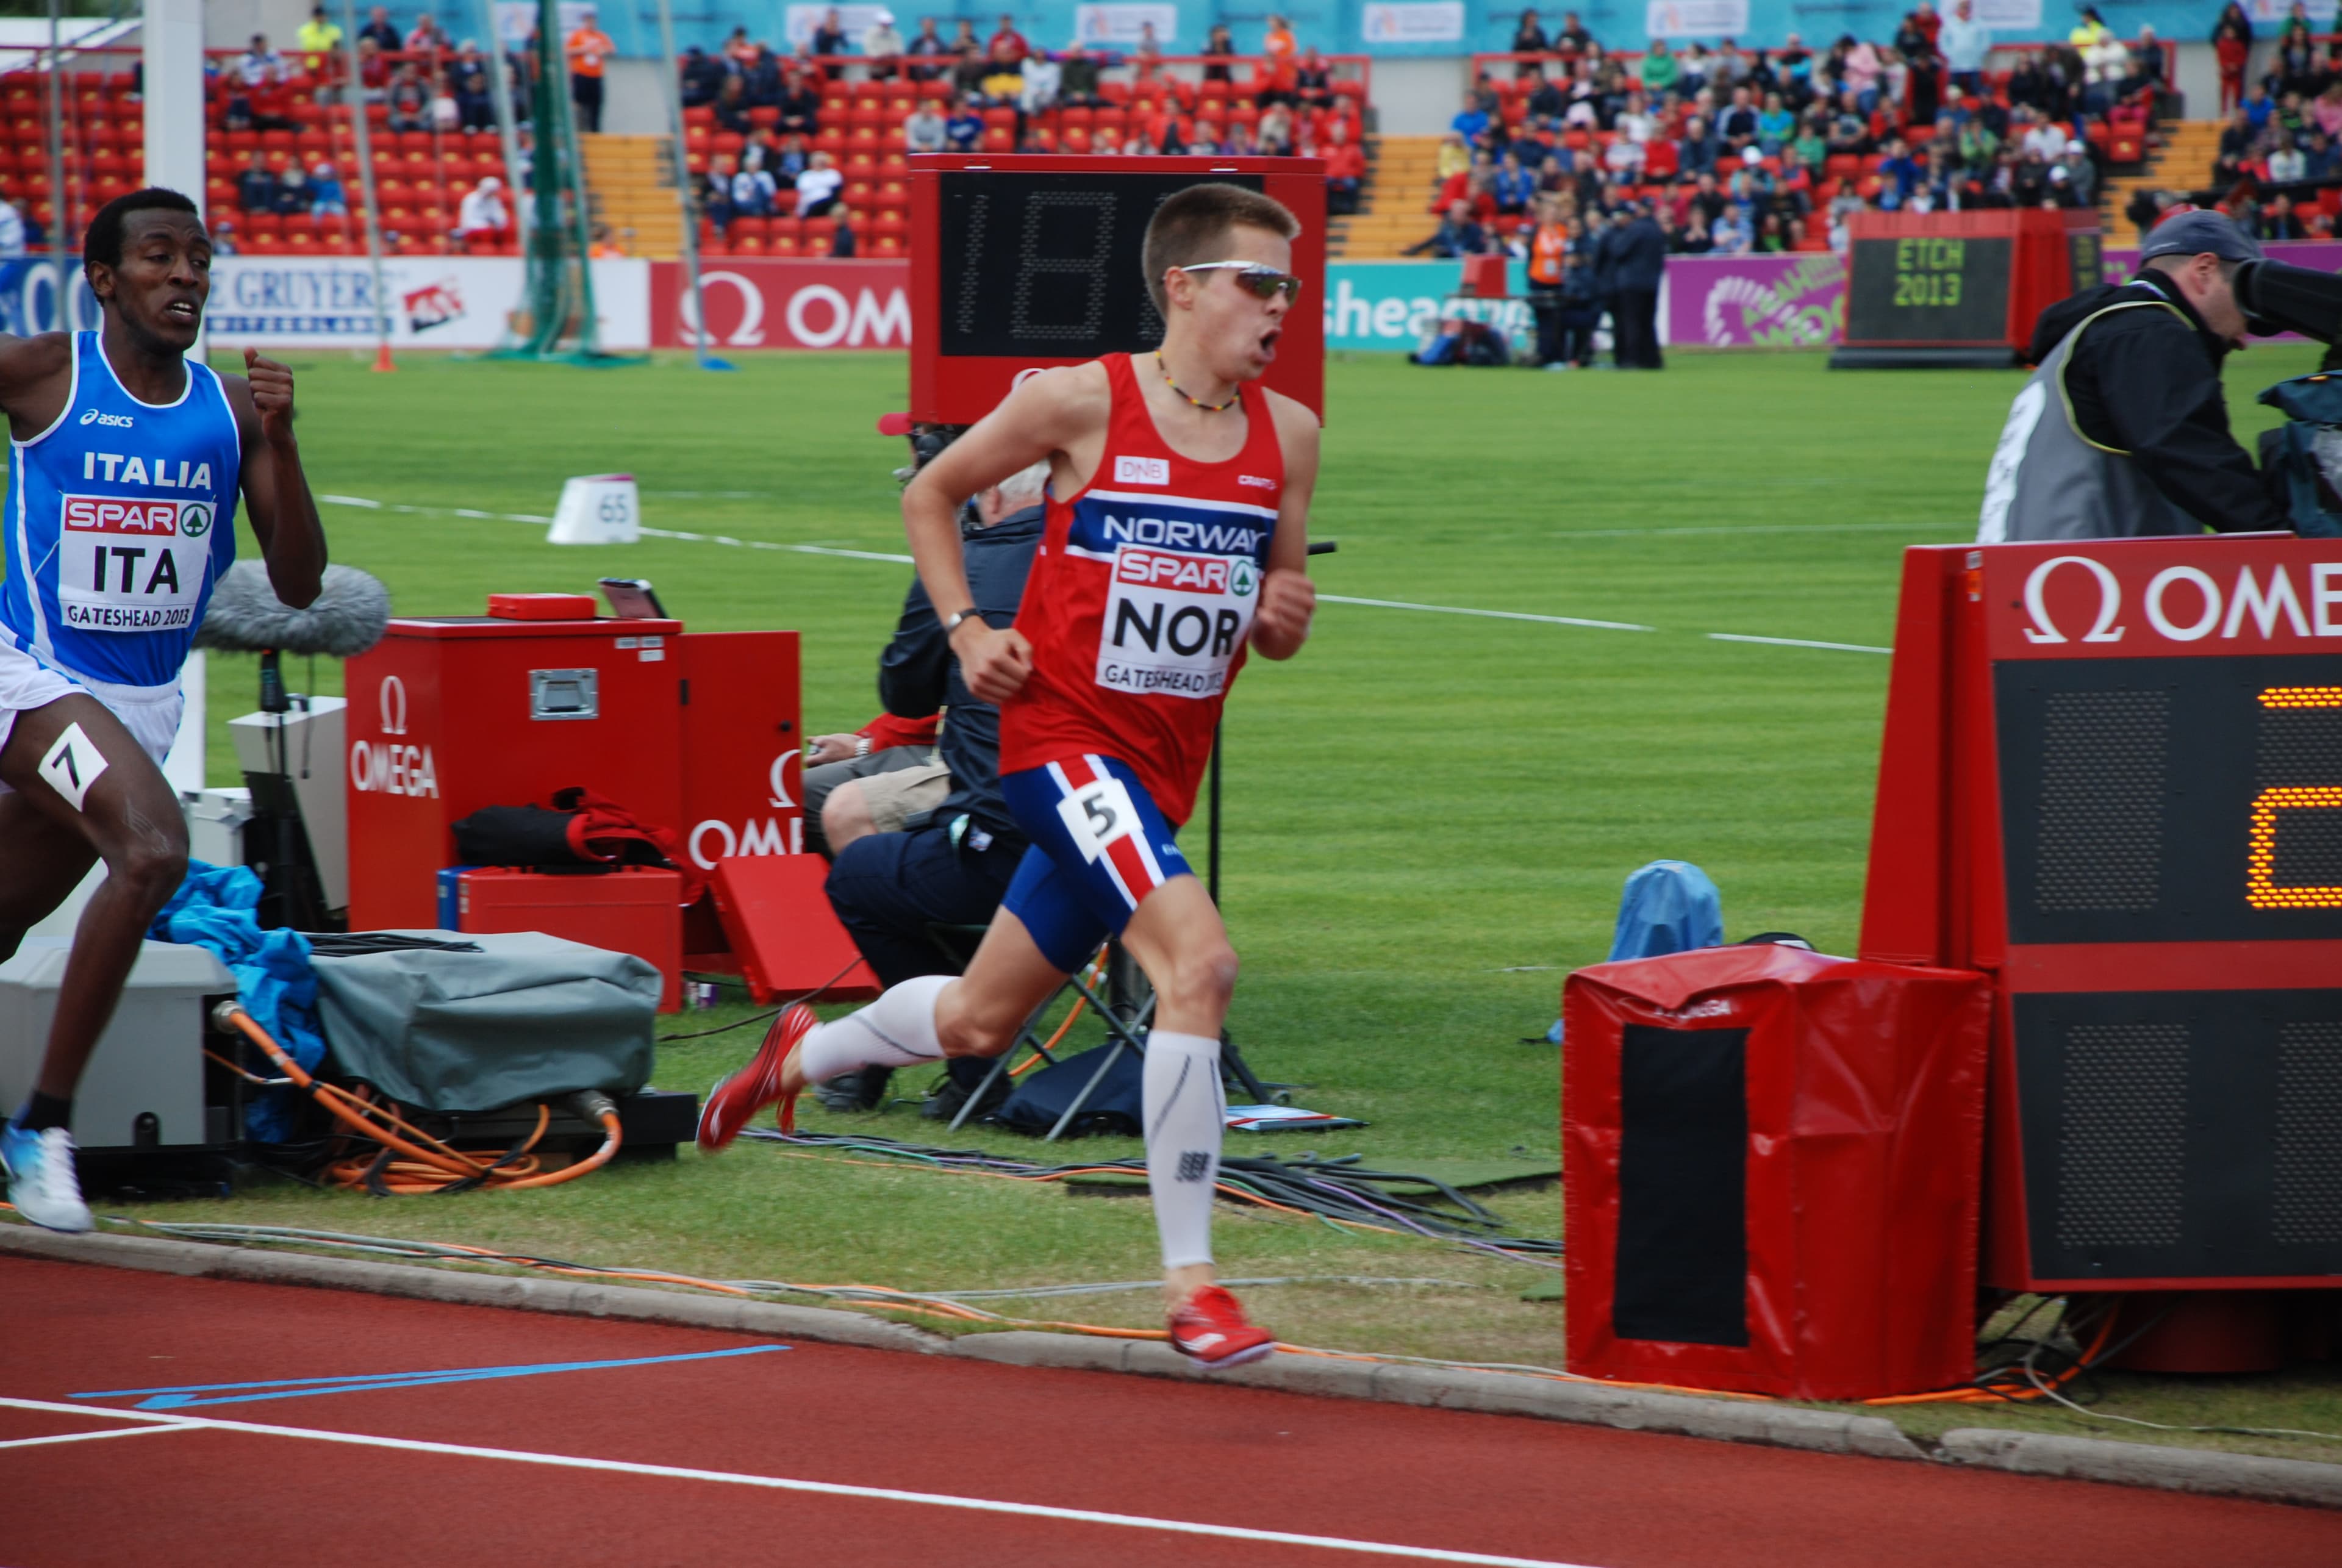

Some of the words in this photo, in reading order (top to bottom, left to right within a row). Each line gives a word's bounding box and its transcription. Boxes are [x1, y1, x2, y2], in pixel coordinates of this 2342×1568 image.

[1893, 273, 1963, 306] 2013
[96, 413, 134, 428] asics
[84, 451, 212, 490] ITALIA
[1122, 460, 1162, 481] DNB
[68, 502, 174, 531] SPAR
[598, 493, 629, 523] 65
[1103, 515, 1269, 553] NORWAY
[93, 545, 179, 594] ITA
[1119, 553, 1227, 590] SPAR
[68, 605, 161, 627] GATESHEAD
[162, 608, 190, 626] 2013
[1112, 597, 1241, 657] NOR
[1105, 664, 1205, 692] GATESHEAD
[51, 741, 80, 791] 7
[351, 740, 440, 800] OMEGA
[1081, 792, 1117, 839] 5
